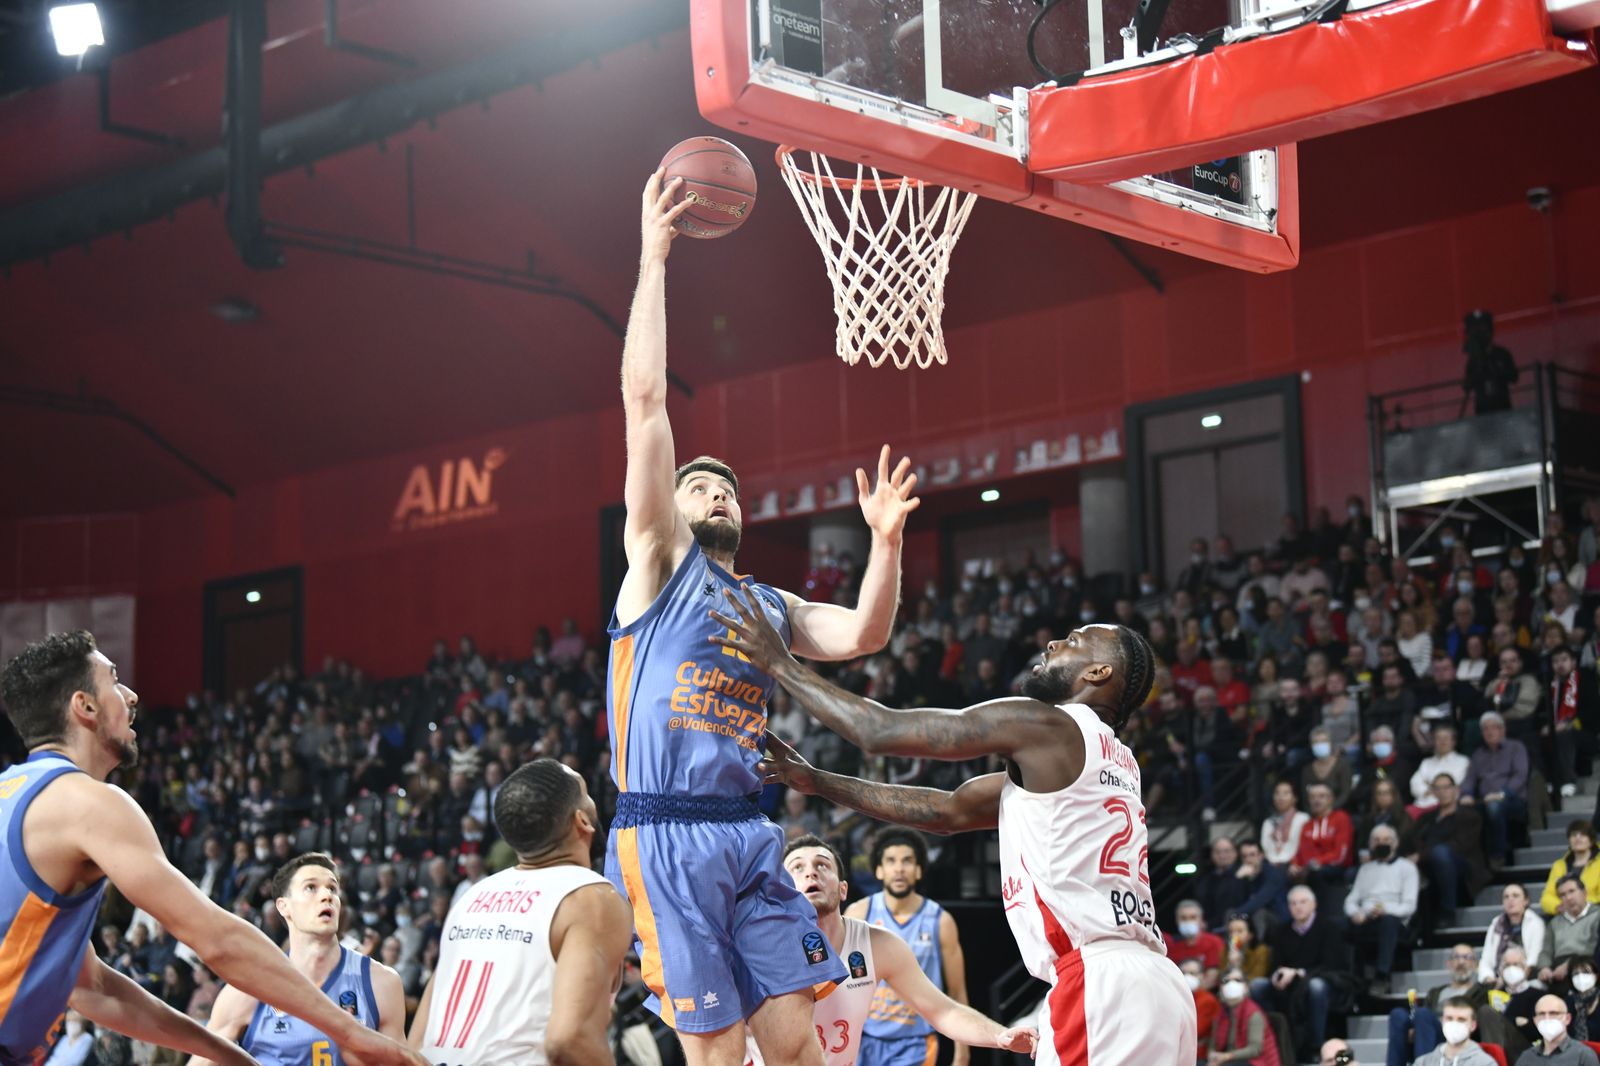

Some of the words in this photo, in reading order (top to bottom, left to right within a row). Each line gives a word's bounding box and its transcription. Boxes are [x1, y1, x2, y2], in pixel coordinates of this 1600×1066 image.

[773, 13, 820, 37] oneteam
[1194, 164, 1229, 188] EuroCup
[393, 457, 492, 519] AIN
[675, 660, 763, 705] Cultura
[466, 890, 541, 914] HARRIS
[448, 924, 494, 942] Charles
[495, 923, 534, 944] Rema
[434, 958, 495, 1049] 11
[312, 1040, 332, 1066] 6
